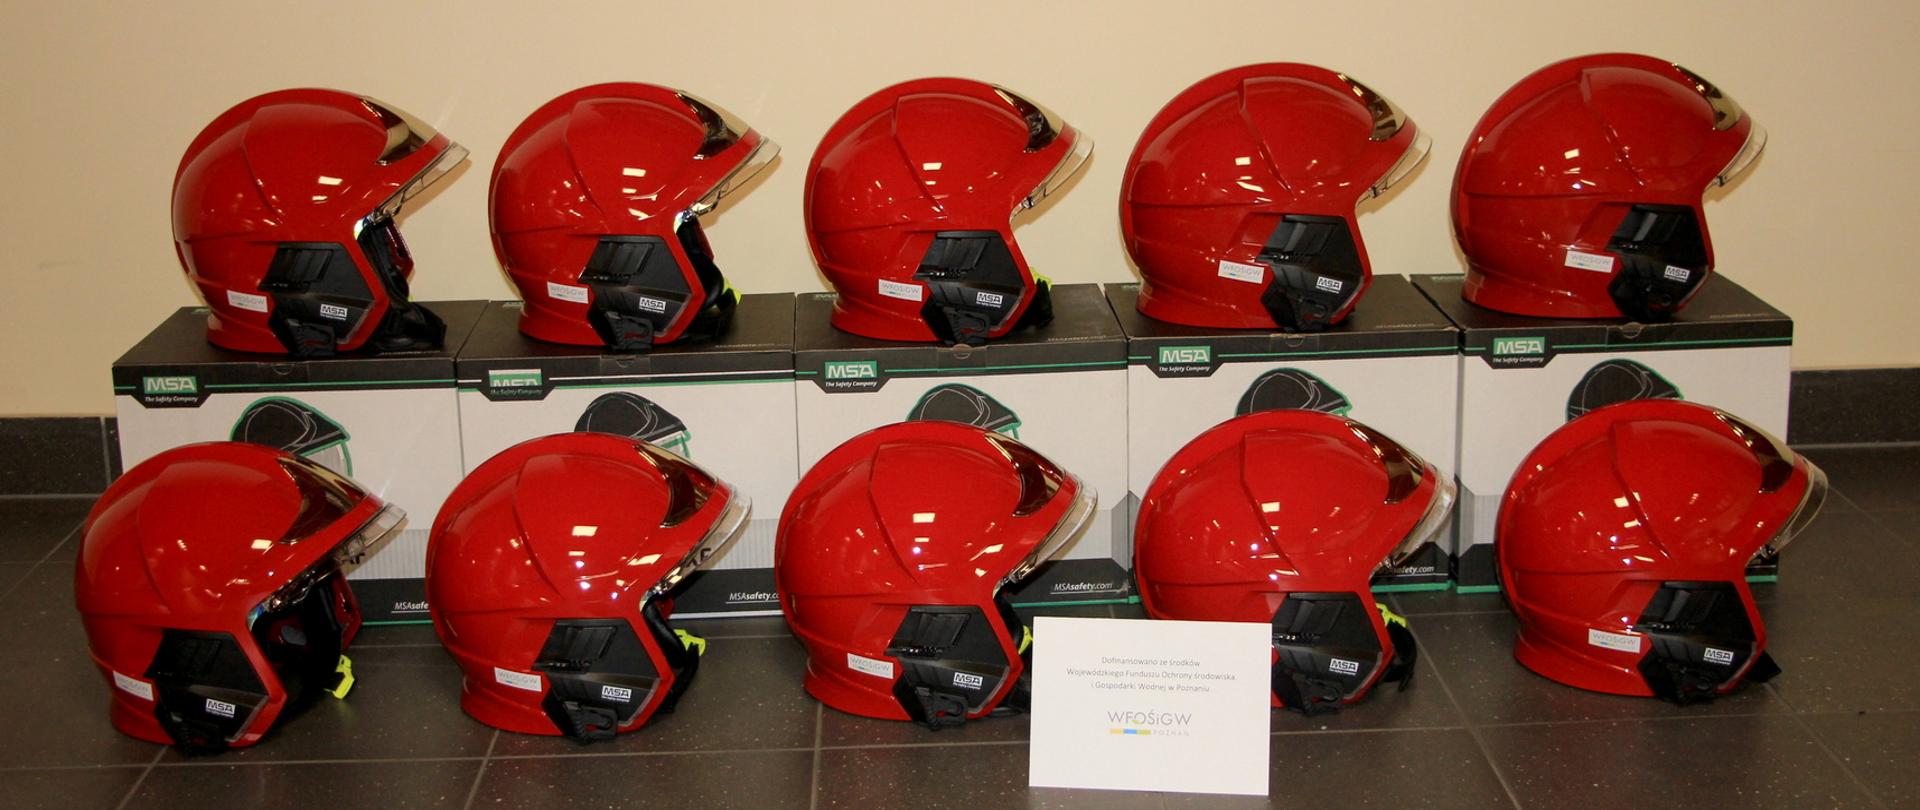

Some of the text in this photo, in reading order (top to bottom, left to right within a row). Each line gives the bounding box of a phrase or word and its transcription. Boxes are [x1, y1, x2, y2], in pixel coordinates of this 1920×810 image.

[1666, 267, 1689, 279] MSA
[1317, 278, 1342, 290] MSA
[640, 298, 665, 310] MSA
[977, 292, 1002, 304] MSA
[321, 305, 346, 317] MSA
[1496, 340, 1543, 354] MSA
[1162, 349, 1209, 363] MSA
[828, 364, 875, 379] MSA
[147, 377, 196, 392] MSA
[1054, 582, 1113, 592] MSAsafety.com
[394, 601, 430, 610] MSAsafe
[1101, 656, 1158, 665] Dofinansowano
[1705, 649, 1732, 661] MSA
[1331, 659, 1358, 671] MSA
[954, 673, 982, 685] MSA
[1125, 670, 1160, 678] Funduszu
[1161, 671, 1193, 680] Ochrony
[603, 686, 631, 698] MSA
[1095, 681, 1136, 690] Gospodarki
[1138, 683, 1166, 692] Wodnej
[1176, 685, 1210, 693] Poznaniu
[207, 700, 234, 713] MSA
[1107, 708, 1192, 726] WFOŚiGW
